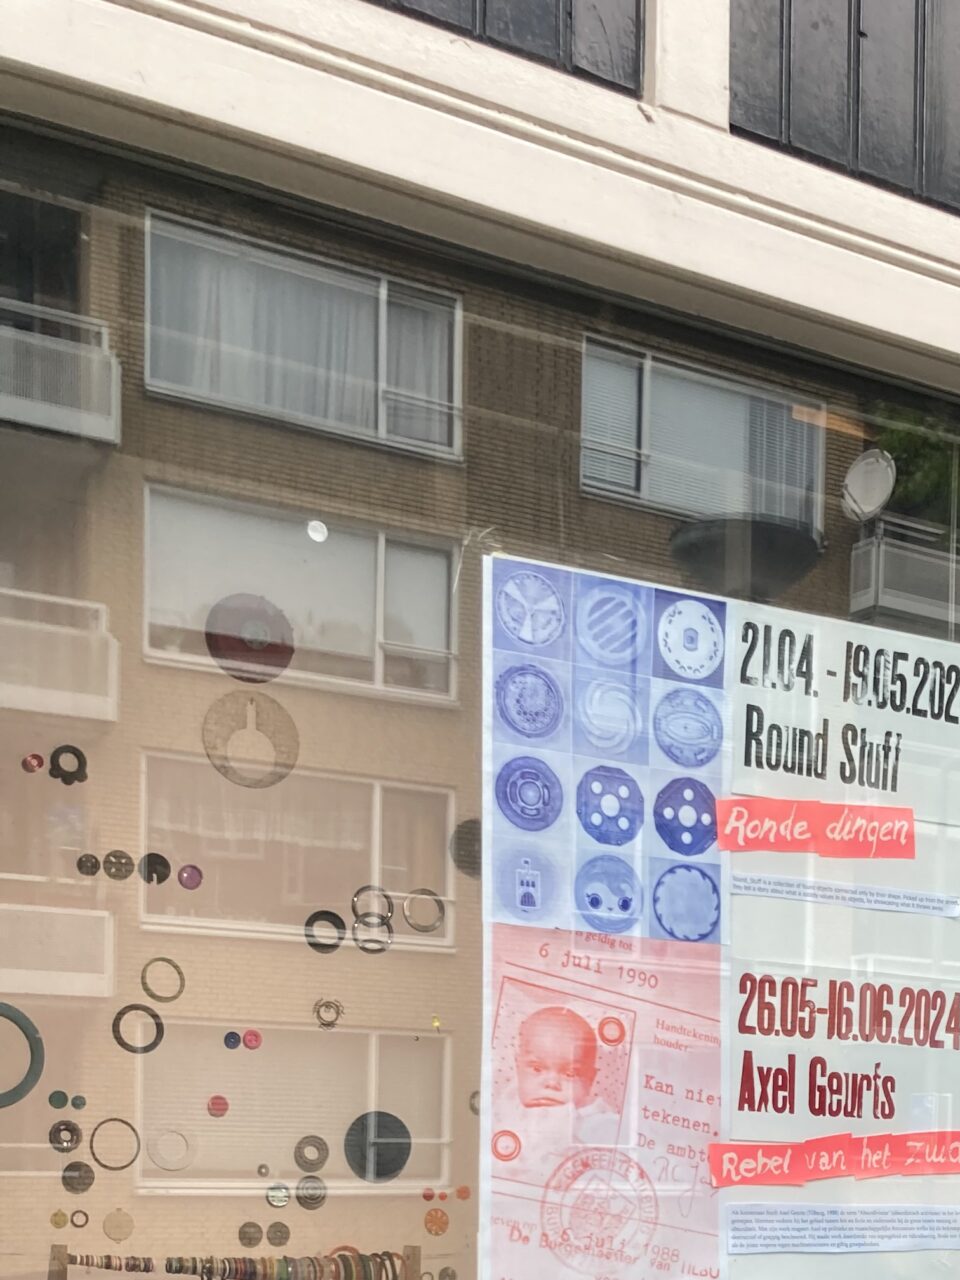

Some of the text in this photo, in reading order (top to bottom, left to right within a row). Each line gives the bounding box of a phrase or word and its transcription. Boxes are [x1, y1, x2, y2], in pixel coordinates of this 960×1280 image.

[740, 621, 819, 698] 21.04.
[743, 703, 903, 793] Round Stuff
[723, 802, 910, 858] Ronde dingen
[538, 942, 659, 989] 6 juli 1990
[643, 1073, 674, 1096] Kan
[737, 1049, 796, 1115] Axel
[637, 1132, 656, 1149] De
[641, 1104, 720, 1137] tekenen.
[721, 1148, 792, 1181] Rebel
[804, 1149, 847, 1171] van
[860, 1136, 892, 1170] het
